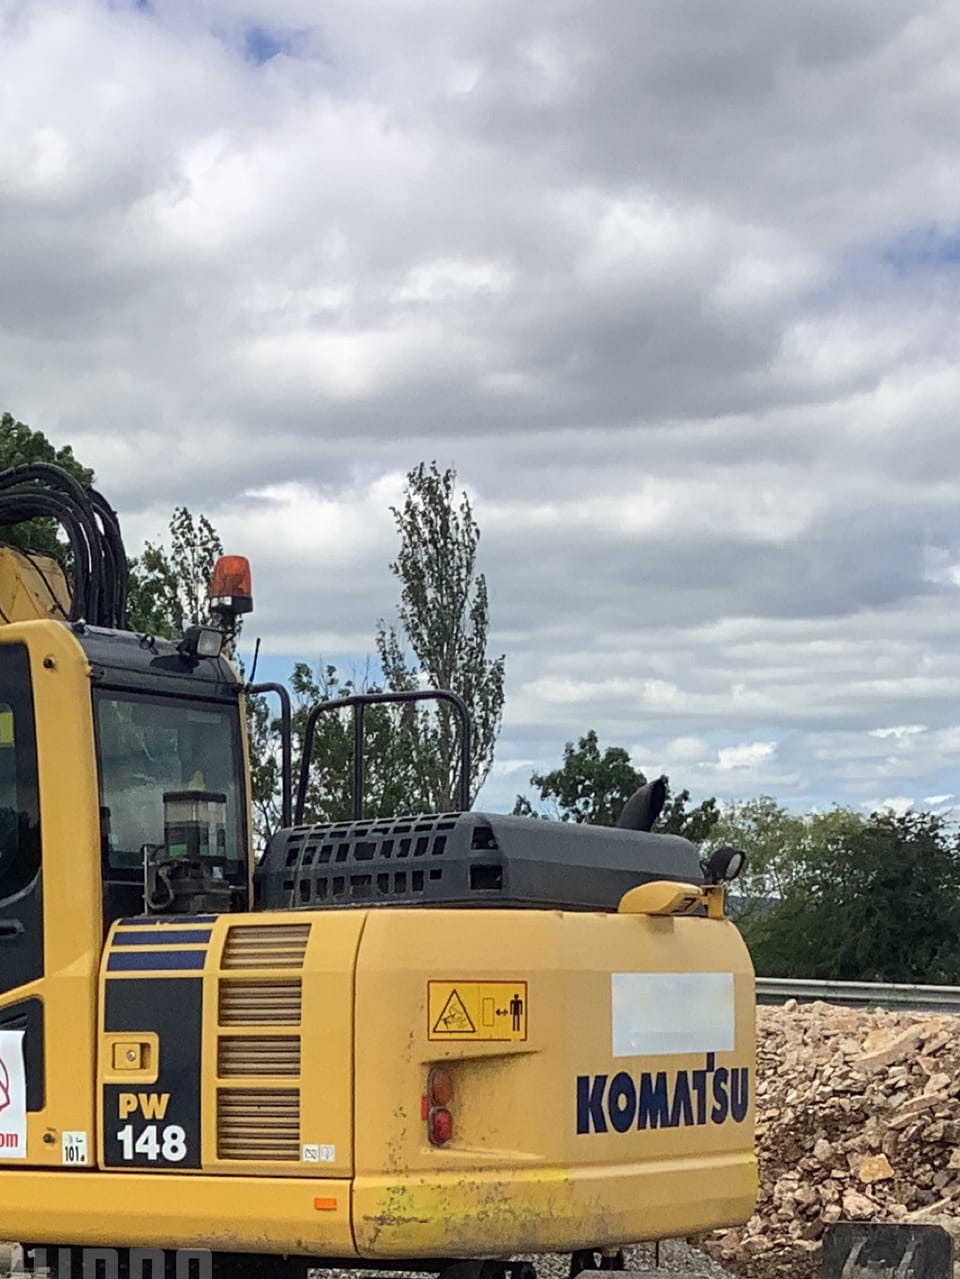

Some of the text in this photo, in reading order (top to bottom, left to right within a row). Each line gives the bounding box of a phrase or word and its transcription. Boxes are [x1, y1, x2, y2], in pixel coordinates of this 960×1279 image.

[119, 1093, 170, 1119] PW
[576, 1052, 749, 1135] KOMATSU
[117, 1124, 187, 1162] 148
